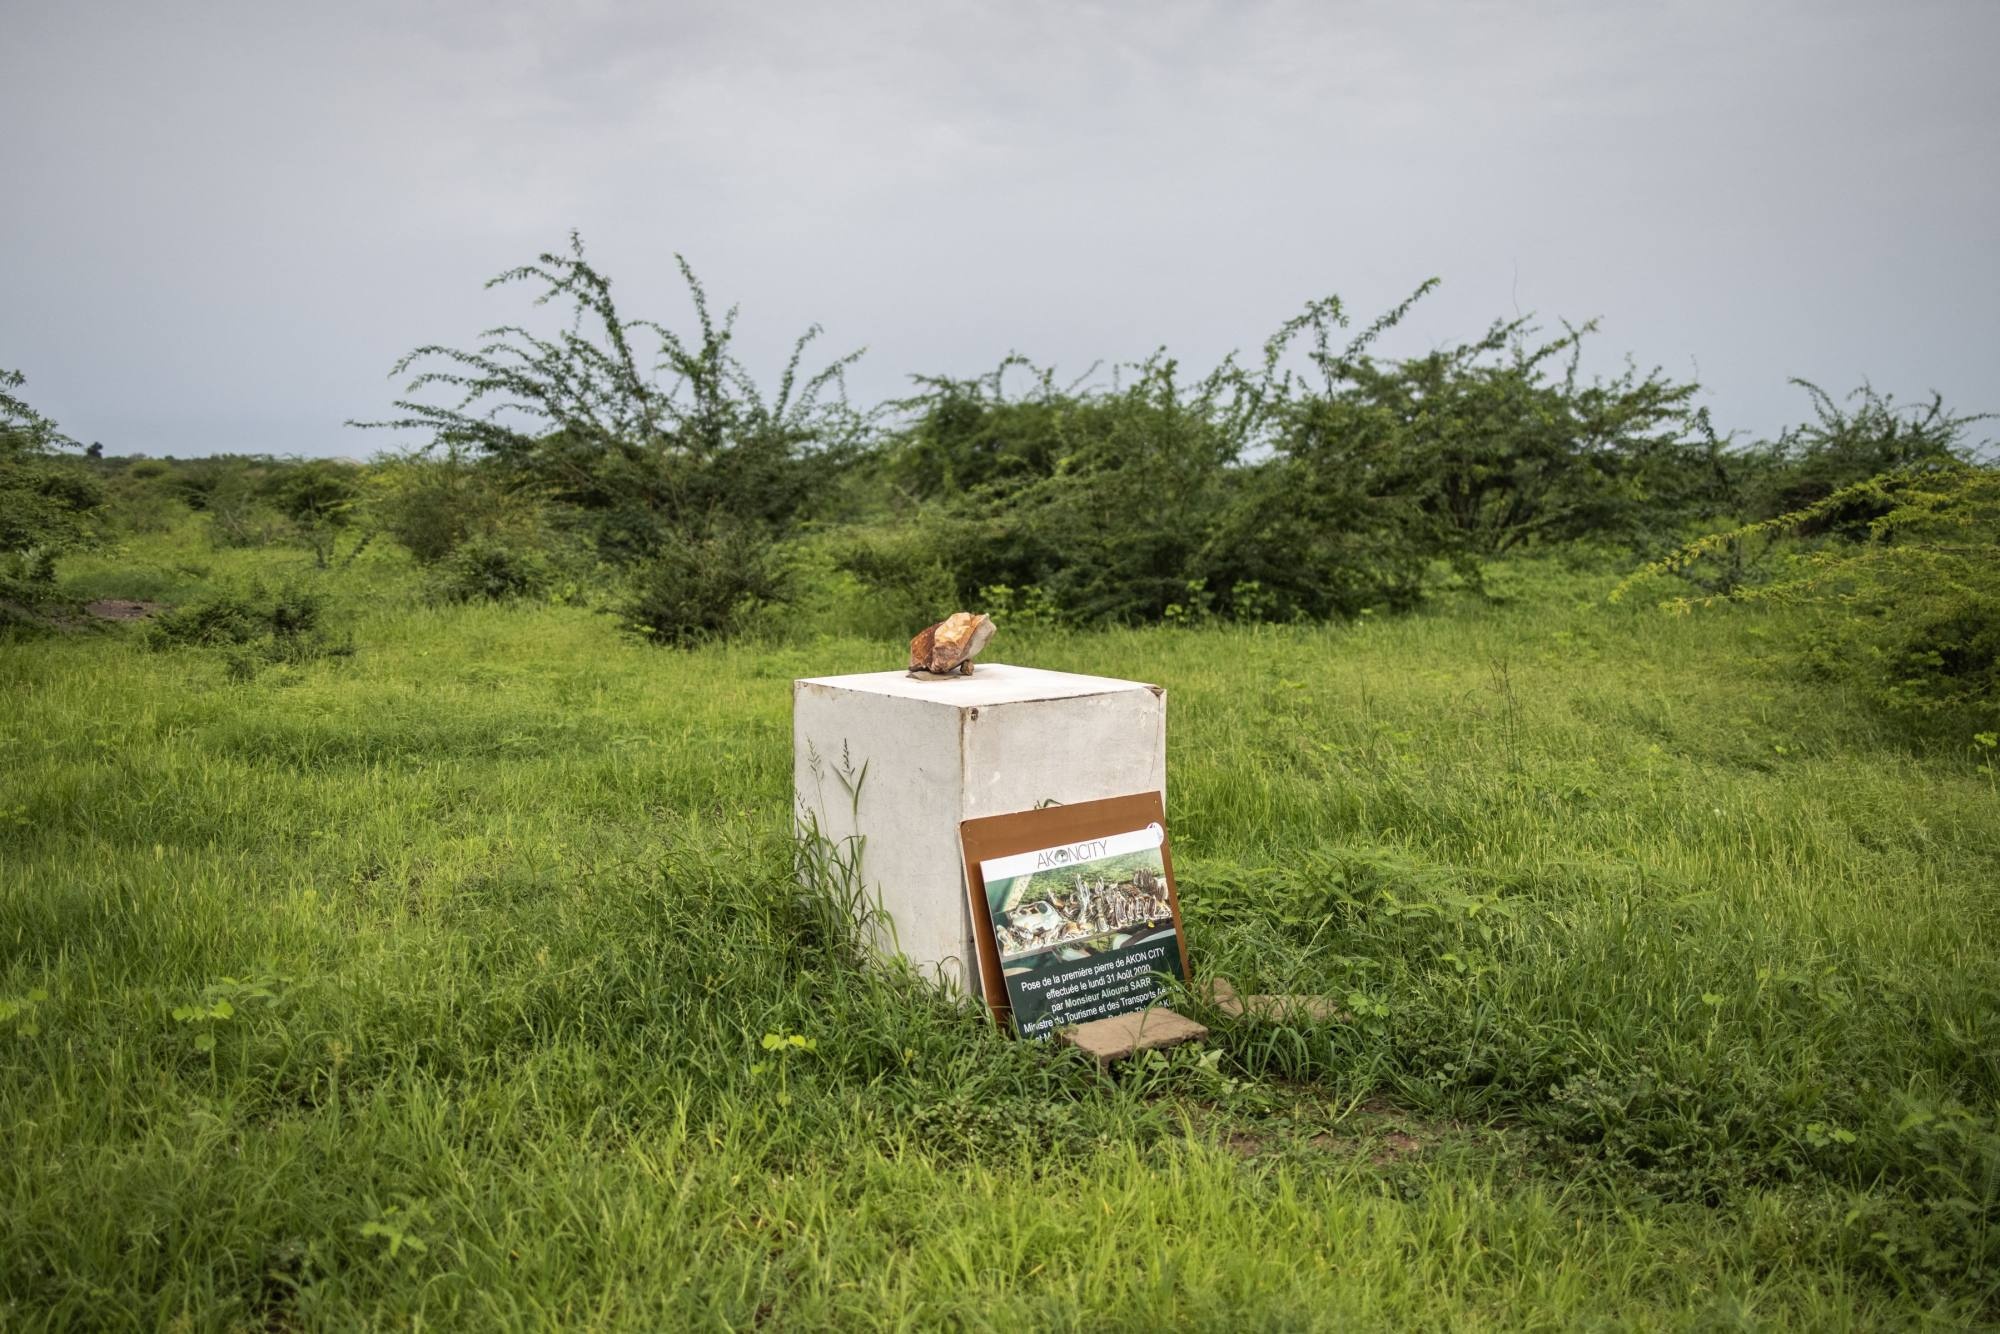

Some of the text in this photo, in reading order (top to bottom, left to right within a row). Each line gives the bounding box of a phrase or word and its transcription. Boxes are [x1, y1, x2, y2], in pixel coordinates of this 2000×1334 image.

[1021, 947, 1165, 991] Pose de la première pierre de AKON CITY
[1046, 964, 1151, 999] effectuée le lundi 31 Août 2020
[1052, 1003, 1063, 1014] par
[1065, 993, 1100, 1009] Monsieur
[1101, 987, 1129, 999] Alioune
[1130, 978, 1152, 990] SARR
[1064, 1008, 1097, 1022] Tourisme
[1099, 1004, 1106, 1012] et
[1107, 1001, 1120, 1011] des
[1120, 991, 1156, 1006] Transports
